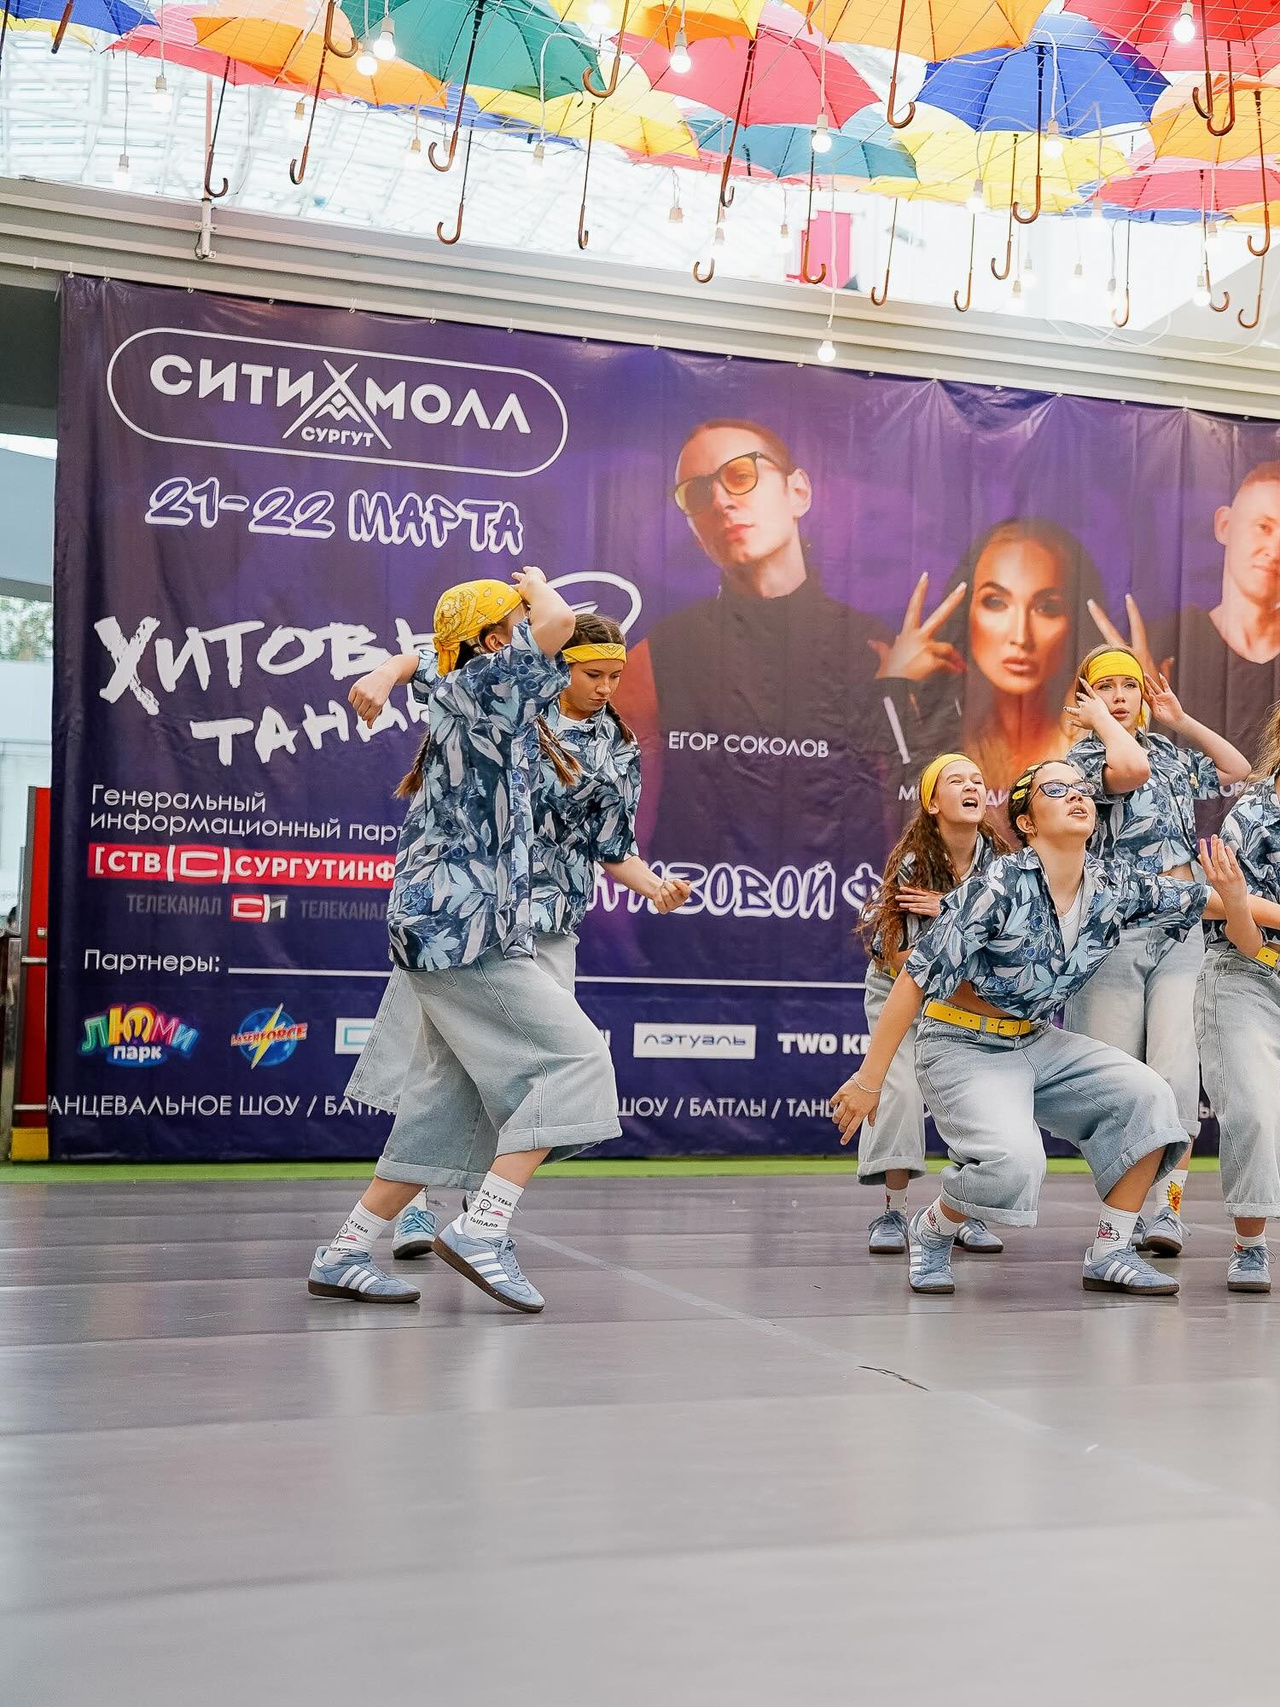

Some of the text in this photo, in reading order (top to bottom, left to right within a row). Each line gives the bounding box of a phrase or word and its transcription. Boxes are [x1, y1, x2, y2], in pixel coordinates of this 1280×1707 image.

[149, 354, 532, 435] СИТИ МОЛЛ
[300, 425, 375, 448] СУРГУТ
[144, 475, 524, 556] 21-22 МАРТА
[668, 730, 830, 759] ЕГОР СОКОЛОВ
[90, 783, 267, 814] Генеральный
[89, 809, 342, 839] информационный
[126, 894, 222, 916] ТЕЛЕКАНАЛ
[83, 948, 221, 976] Партнеры:
[113, 1045, 162, 1063] парк
[777, 1032, 839, 1055] TWO
[48, 1094, 232, 1118] АНЦЕВАЛЬНОЕ
[239, 1095, 301, 1116] ШОУ
[689, 1096, 767, 1118] БАТТЛЫ
